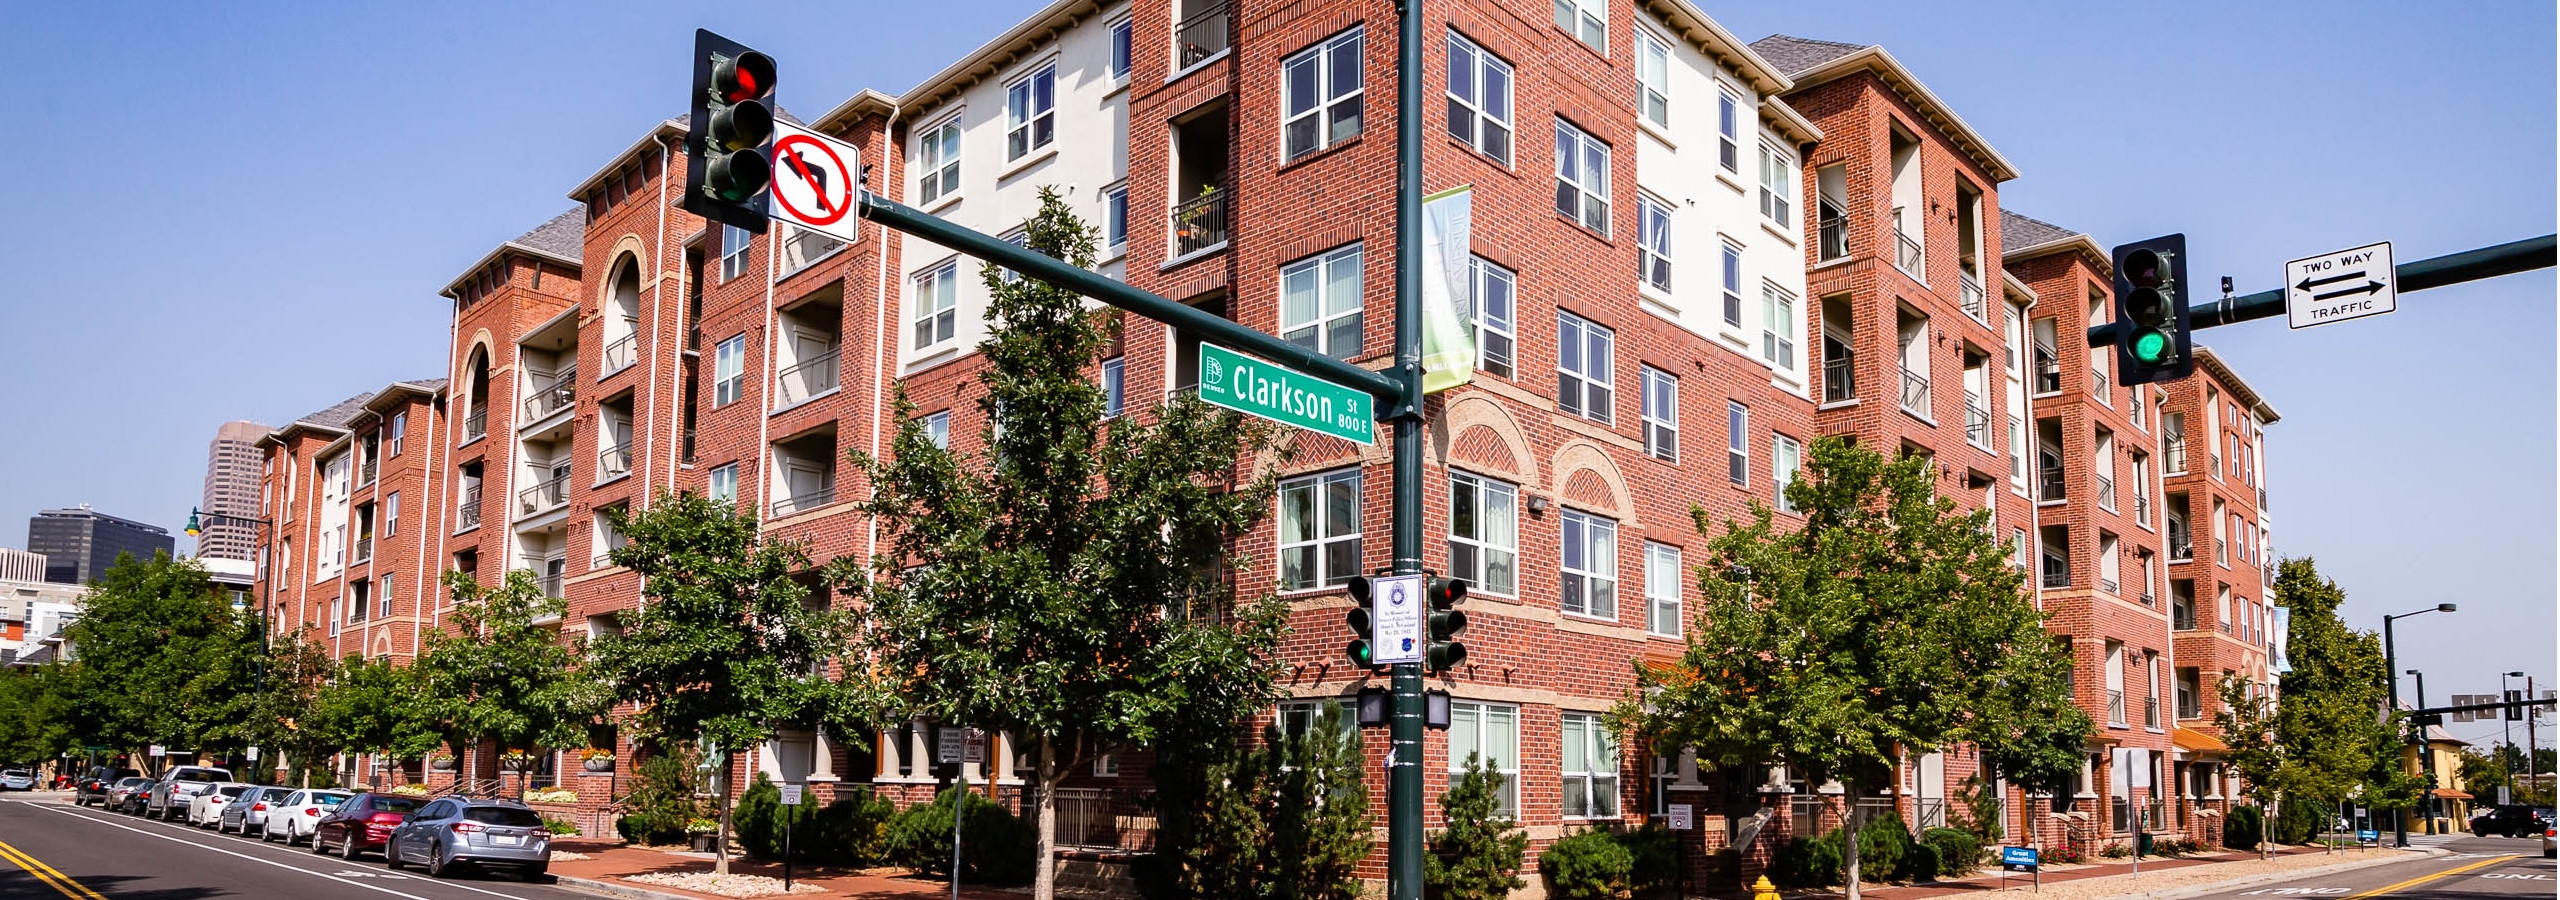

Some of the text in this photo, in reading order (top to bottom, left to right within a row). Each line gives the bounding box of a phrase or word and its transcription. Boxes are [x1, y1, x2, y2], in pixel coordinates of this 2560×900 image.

[1452, 210, 1467, 282] AVENUE
[2303, 251, 2373, 274] TWO WAY
[2311, 300, 2372, 319] TRAFFIC
[1202, 382, 1225, 394] DENVER
[1233, 365, 1358, 424] Clarkson St
[1338, 413, 1367, 434] 800 E
[2005, 855, 2035, 863] Amenities
[2238, 887, 2353, 896] ONLY
